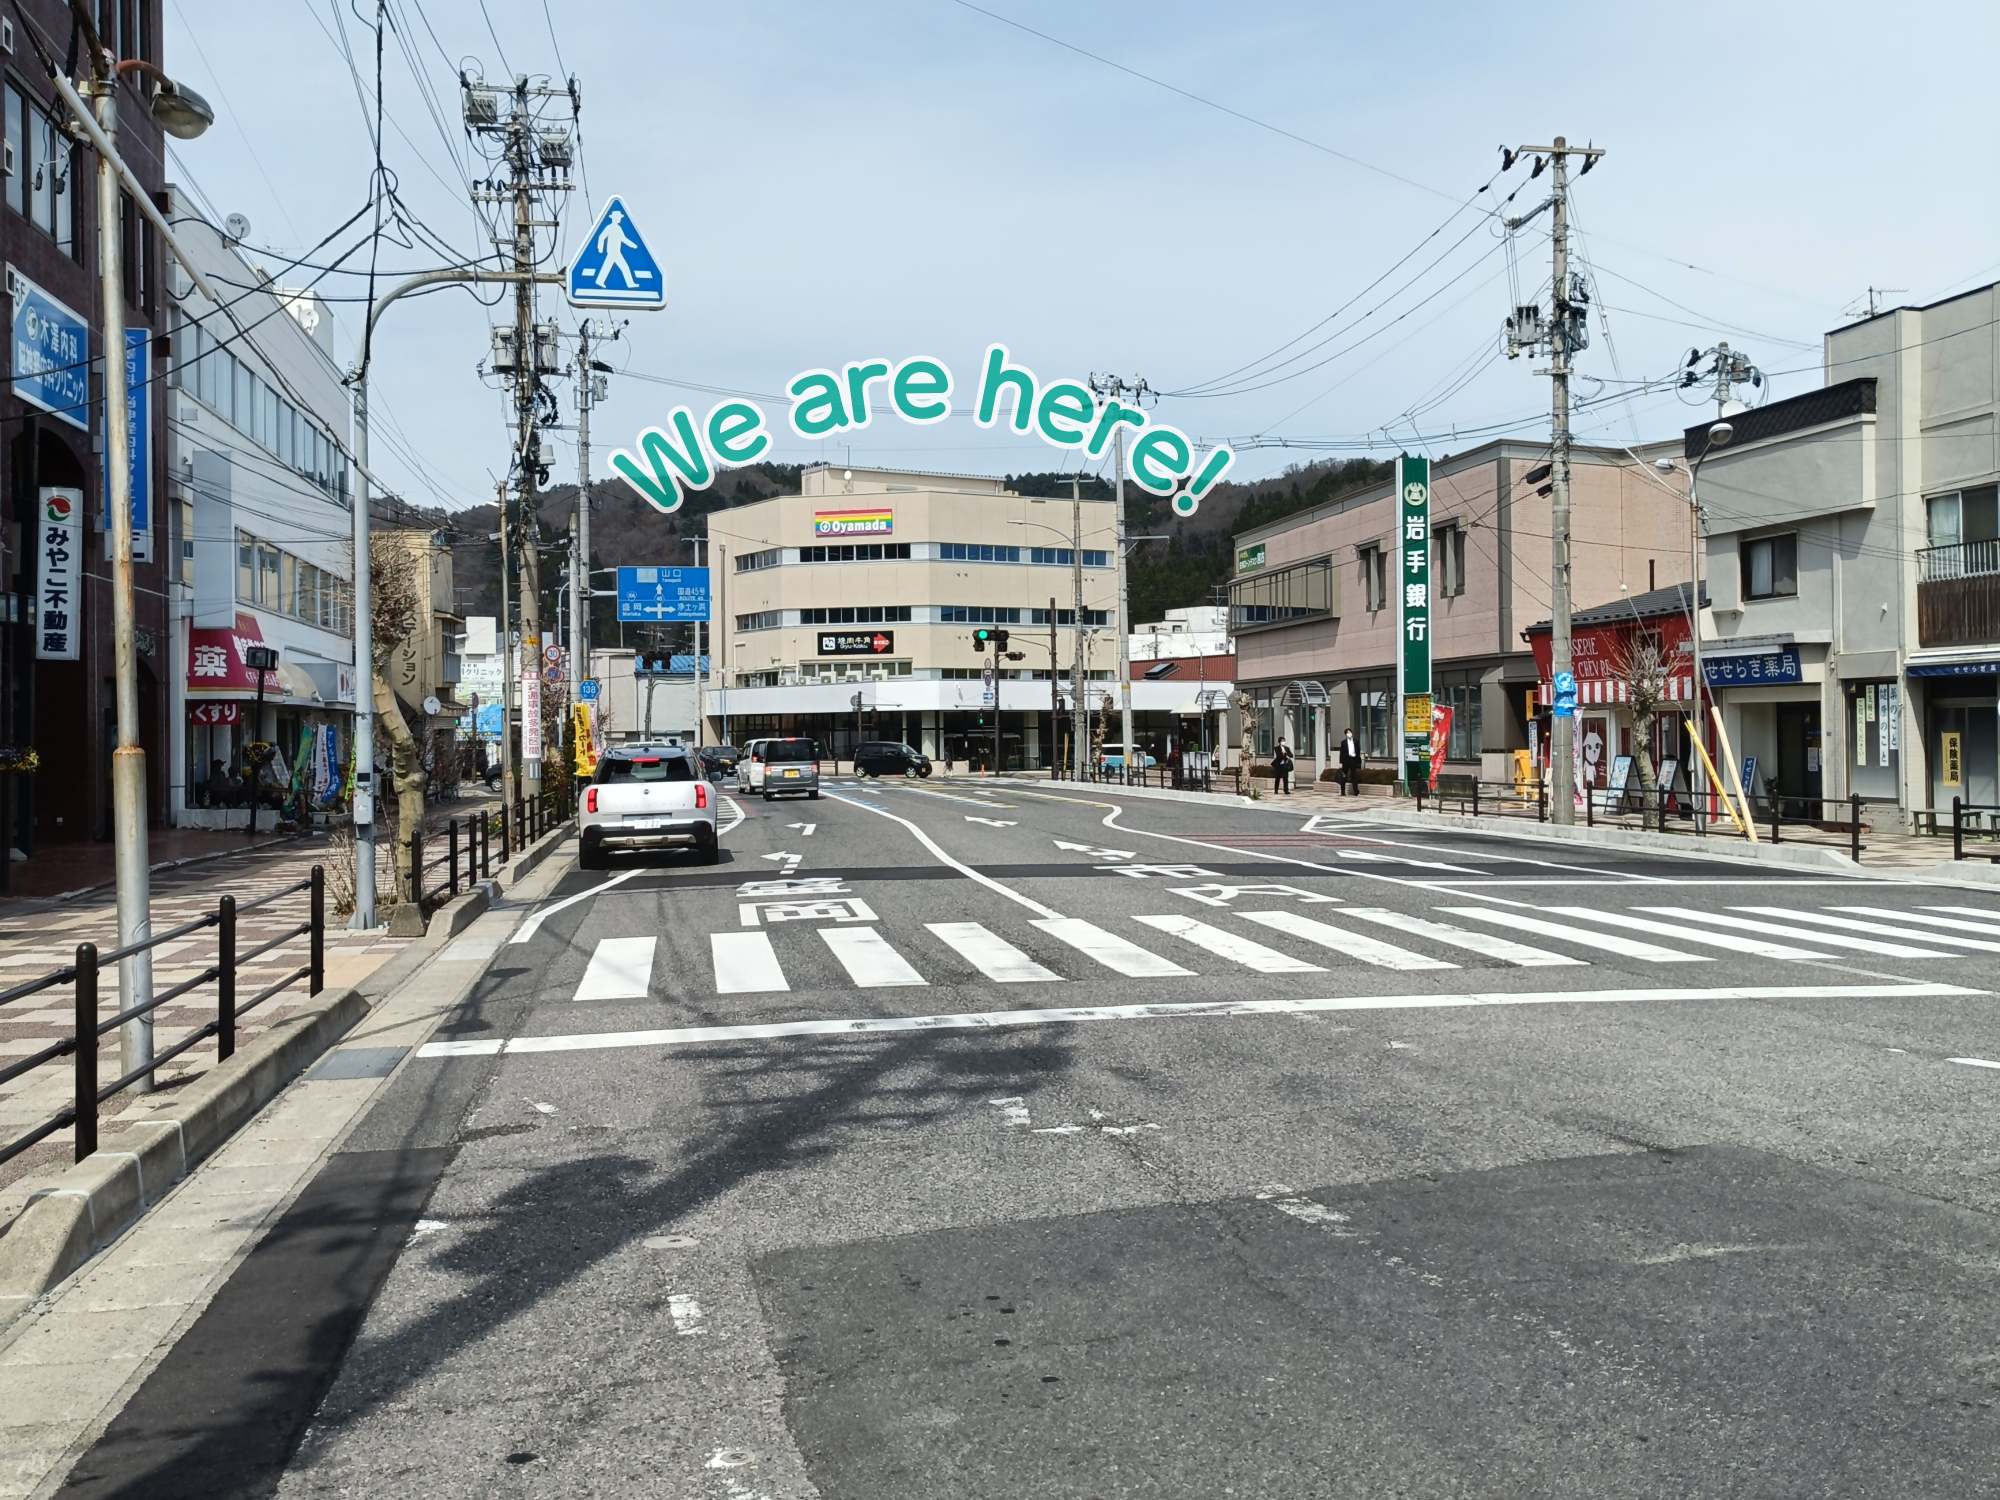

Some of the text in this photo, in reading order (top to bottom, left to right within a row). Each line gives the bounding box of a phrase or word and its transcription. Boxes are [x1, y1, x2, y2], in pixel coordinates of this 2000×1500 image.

[15, 278, 26, 308] 5F
[832, 519, 887, 534] Oyamada
[662, 569, 682, 578] 山口
[1405, 515, 1427, 641] 岩手銀行
[43, 526, 70, 653] みやこ不動産
[677, 587, 706, 596] 国道45号
[622, 603, 642, 611] 盛岡
[194, 645, 228, 678] 薬
[549, 649, 558, 658] 30
[1705, 654, 1796, 680] せせらぎ薬局
[582, 685, 597, 694] 138
[195, 703, 237, 722] くすり
[527, 681, 540, 755] 交通事故多発区間
[1949, 737, 1959, 783] 保険薬局
